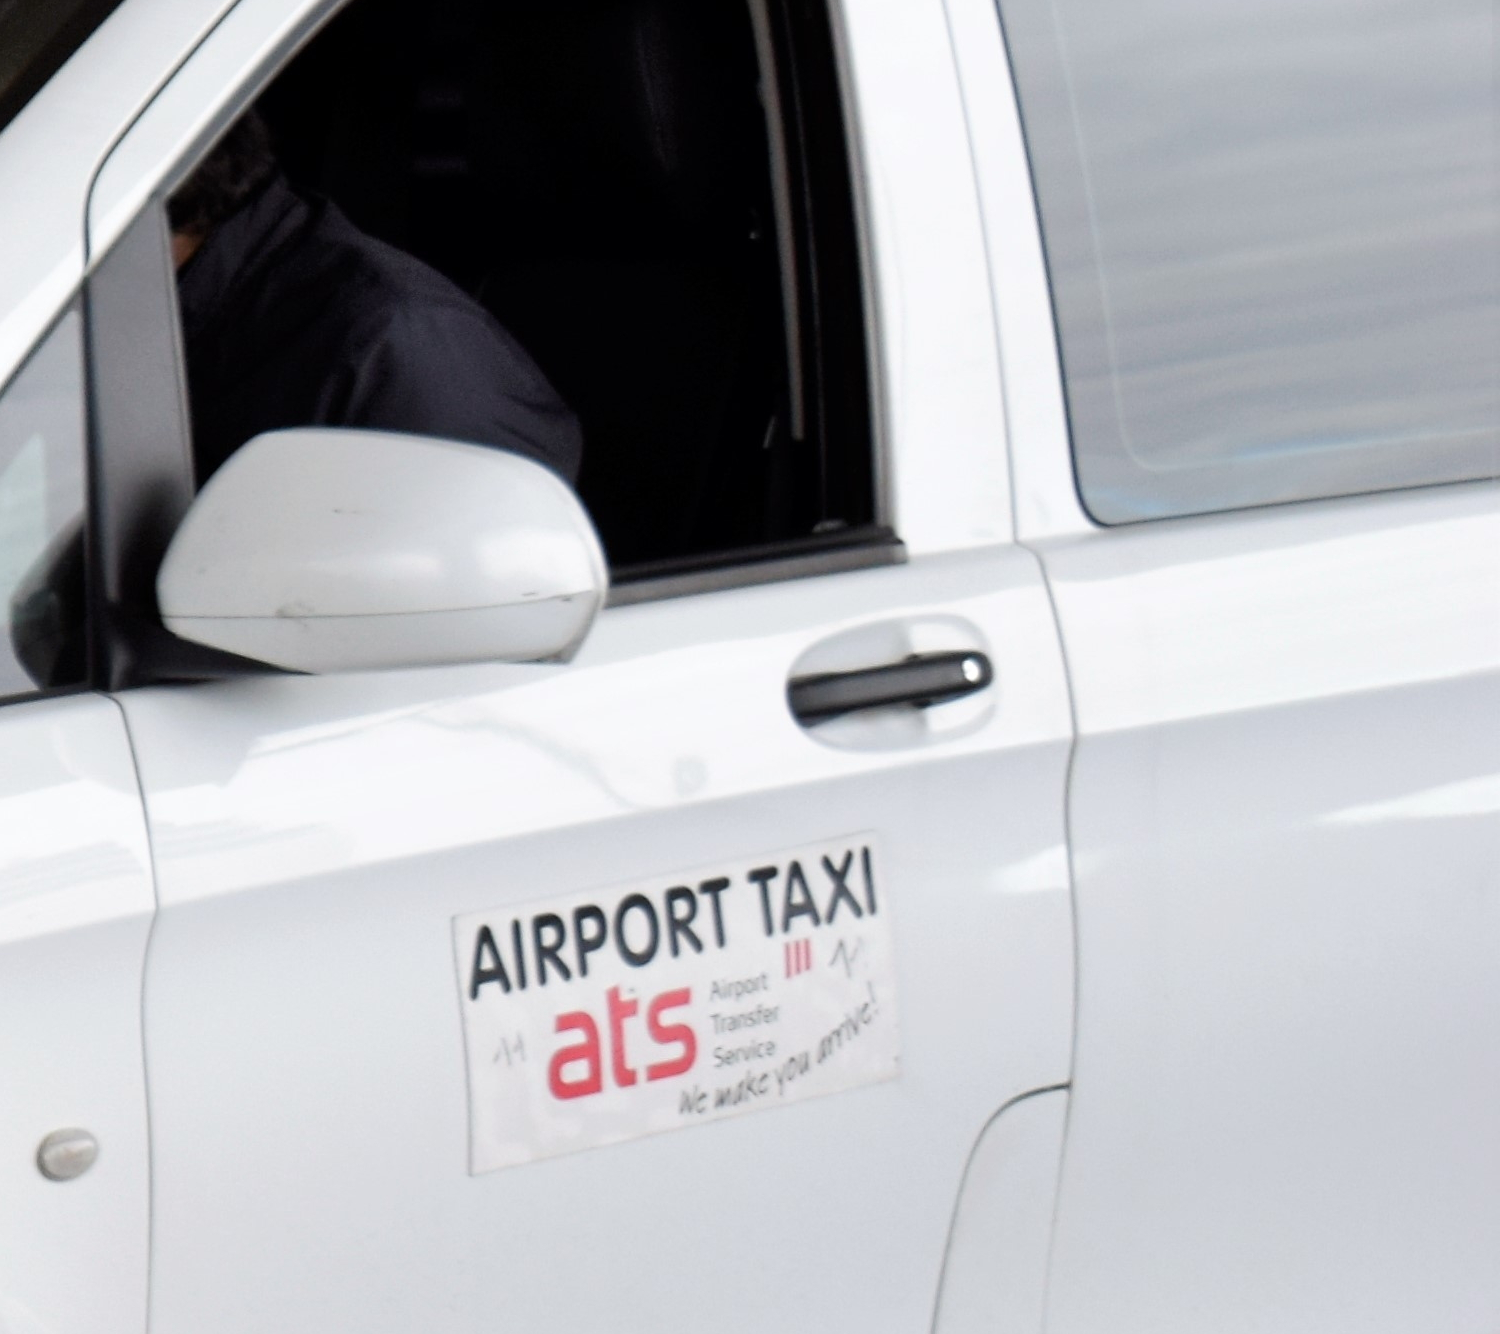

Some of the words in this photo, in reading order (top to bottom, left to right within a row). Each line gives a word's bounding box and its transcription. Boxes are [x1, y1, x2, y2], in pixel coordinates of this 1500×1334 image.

[468, 876, 732, 1000] AIRPORT
[747, 845, 879, 937] TAXI
[709, 972, 770, 1001] Airport
[710, 1004, 780, 1035] Transfer
[547, 983, 699, 1102] ats
[678, 1084, 708, 1115] We
[713, 1070, 770, 1108] make
[774, 1050, 810, 1097] you
[816, 980, 881, 1065] arrive!
[712, 1038, 776, 1068] Service
